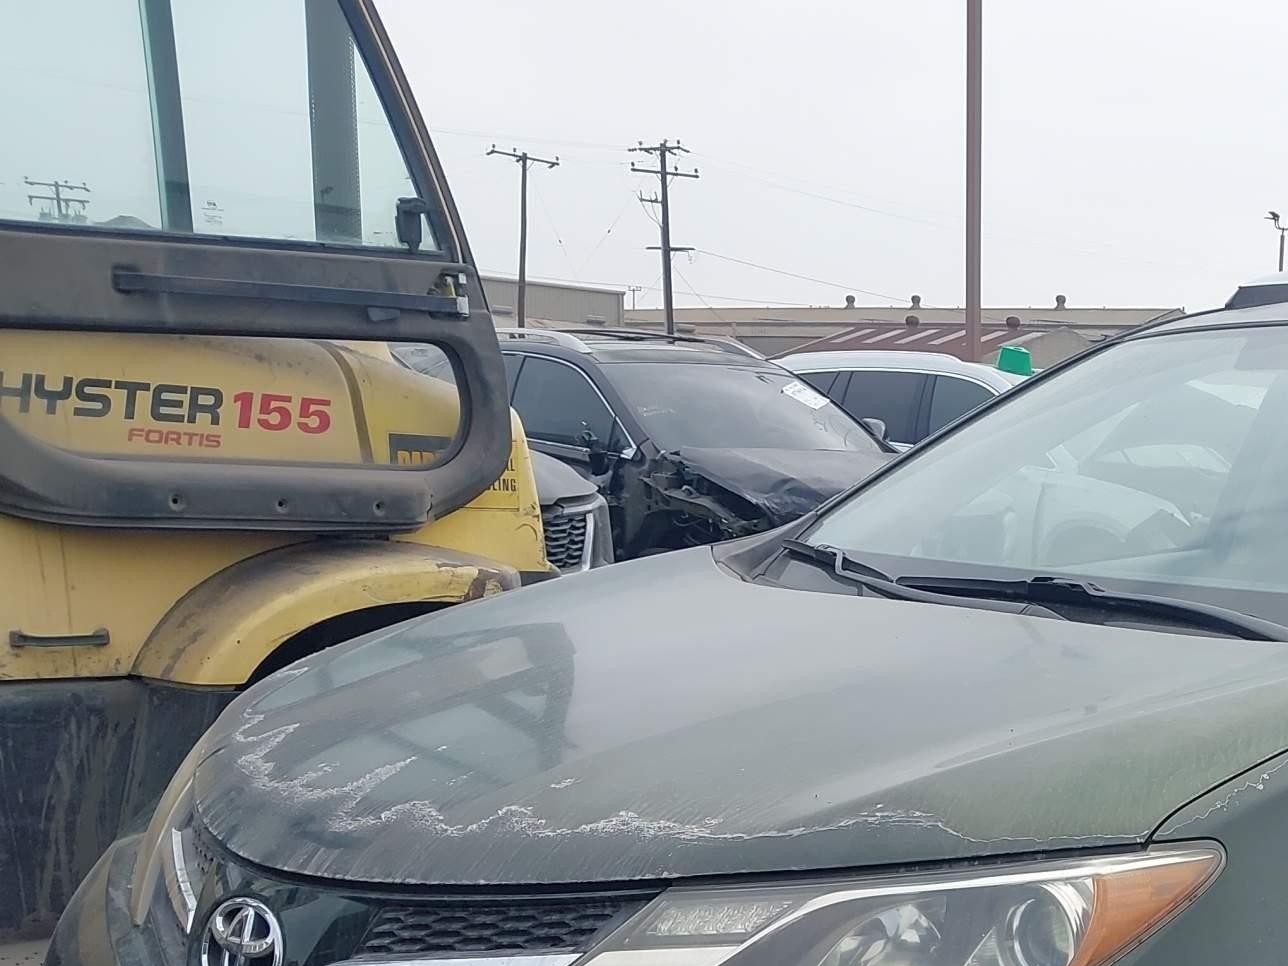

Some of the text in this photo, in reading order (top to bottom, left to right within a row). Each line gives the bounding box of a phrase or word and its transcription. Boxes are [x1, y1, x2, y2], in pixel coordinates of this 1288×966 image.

[0, 370, 332, 434] HYSTER 155
[127, 428, 222, 449] FORTIS
